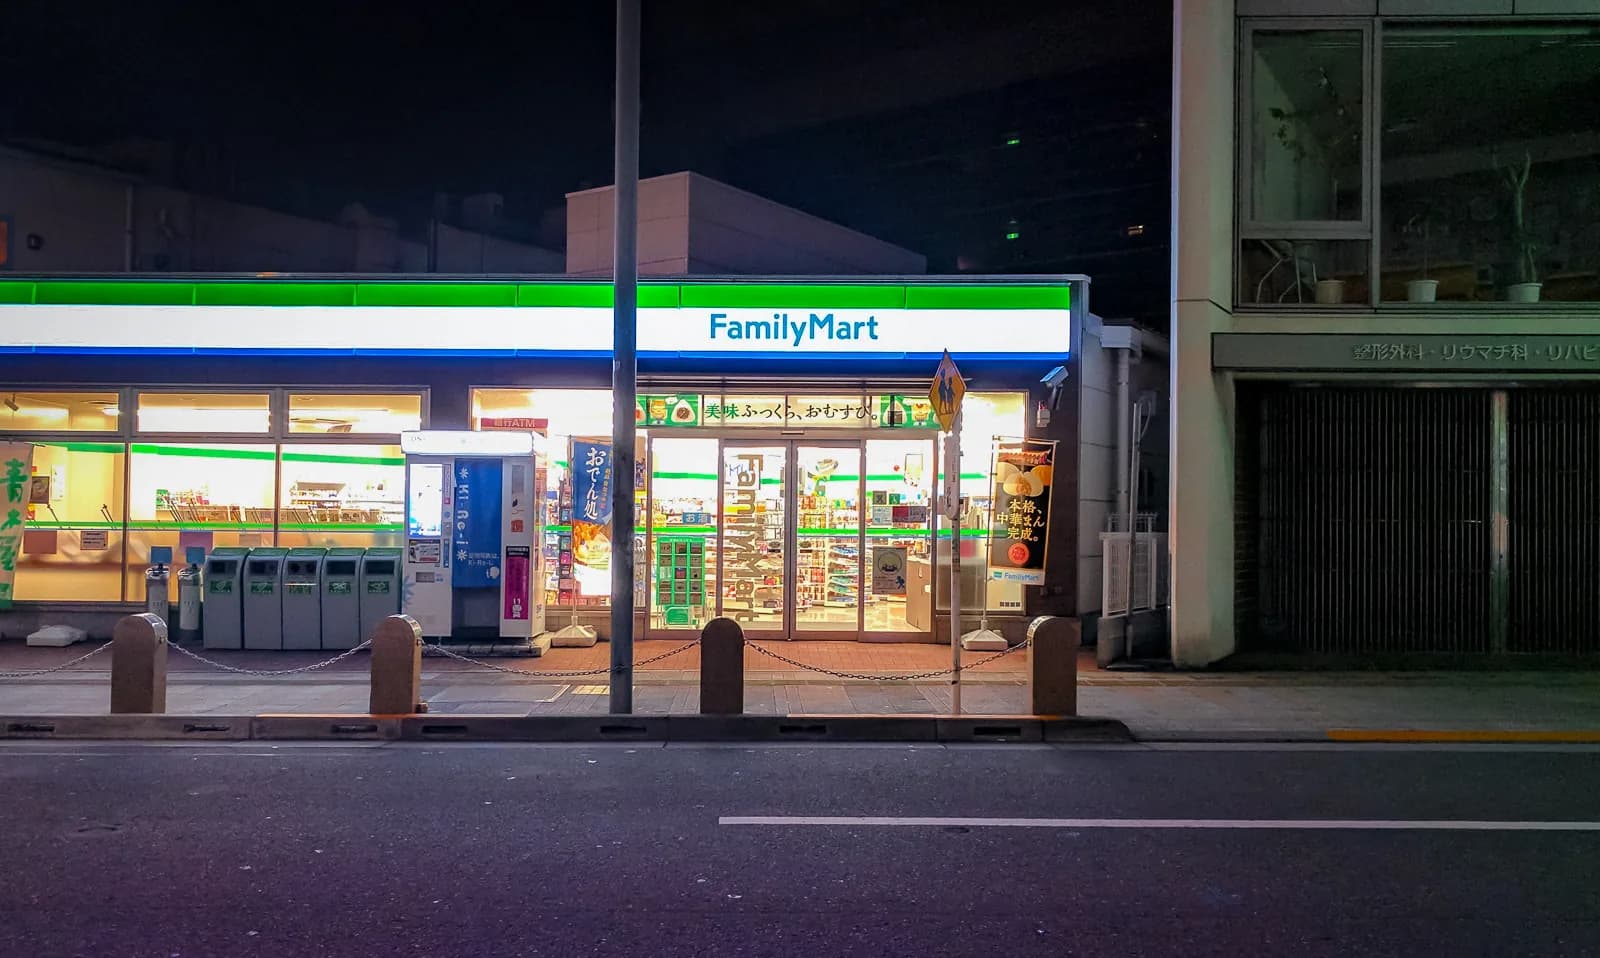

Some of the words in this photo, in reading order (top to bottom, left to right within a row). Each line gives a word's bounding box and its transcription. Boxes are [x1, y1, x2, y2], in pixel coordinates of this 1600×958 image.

[710, 313, 878, 347] FamilyMart
[704, 403, 878, 421] 美味ふっくら、おむすび。
[583, 447, 606, 520] おでん処
[1009, 498, 1043, 514] 本格、
[996, 512, 1045, 527] 中華まん
[729, 454, 764, 622] FamilyMart
[1007, 527, 1039, 542] 完成。
[1004, 571, 1041, 581] FamilyMart
